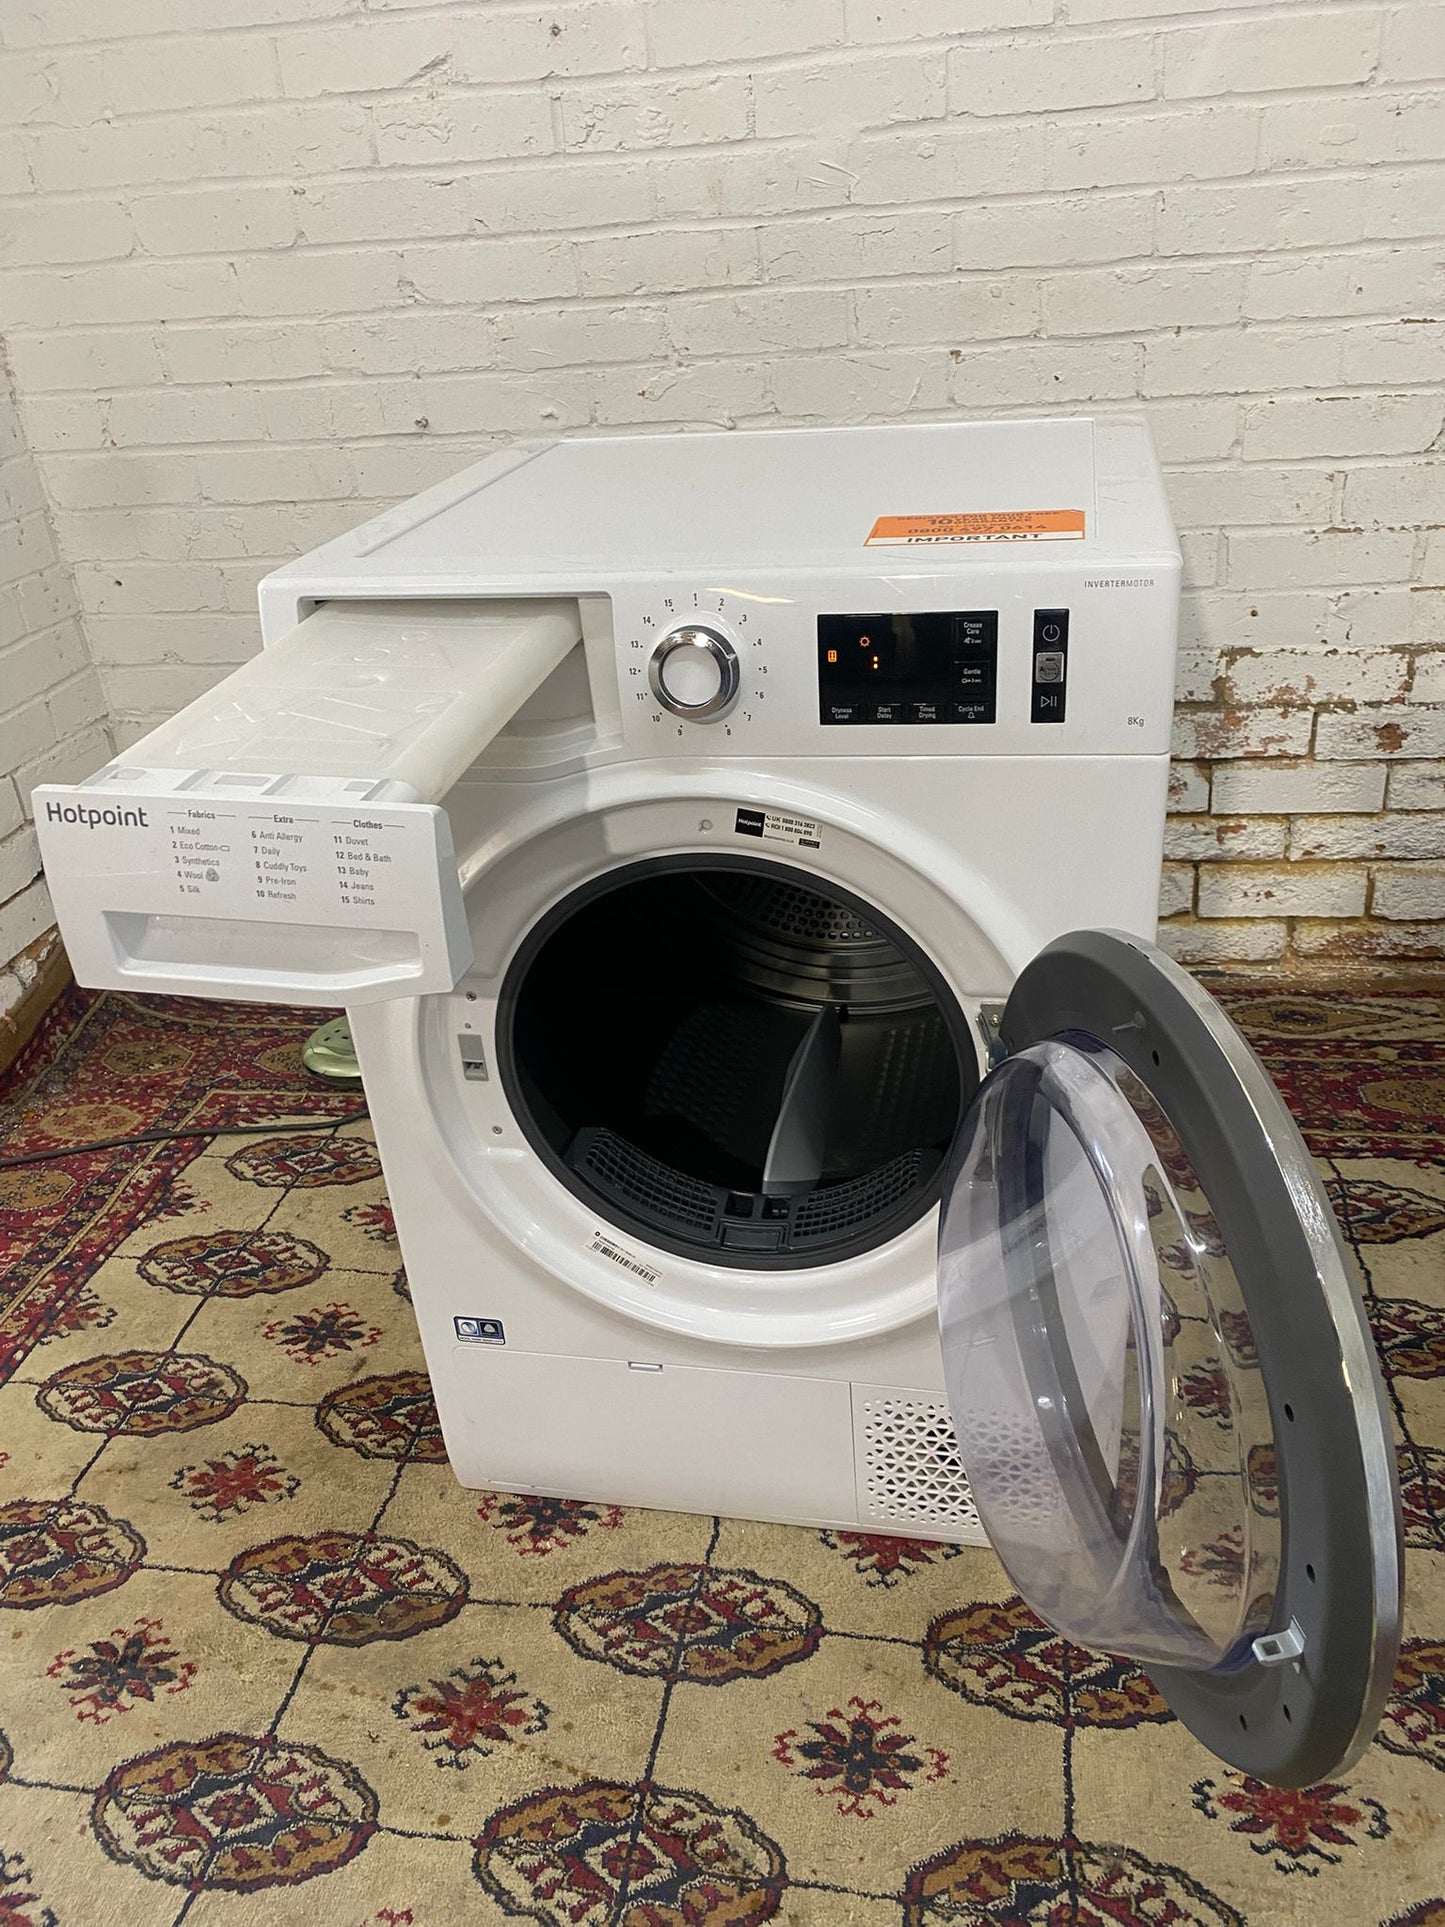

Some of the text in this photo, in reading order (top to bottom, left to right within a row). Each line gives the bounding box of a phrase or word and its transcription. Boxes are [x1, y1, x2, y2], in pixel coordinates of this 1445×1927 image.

[907, 533, 1043, 543] IMPORTANT
[1084, 580, 1155, 588] INVERTERMOTOR
[693, 593, 697, 601] 1
[719, 598, 725, 606] 2
[664, 599, 673, 607] 15
[643, 616, 651, 624] 14
[742, 614, 747, 622] 3
[963, 621, 983, 629] Crease
[756, 638, 762, 646] 4
[629, 667, 637, 675] 12
[763, 666, 768, 674] 5
[636, 693, 644, 701] 11
[759, 691, 765, 699] 6
[958, 705, 973, 713] Cycle
[877, 712, 892, 720] Delay
[918, 712, 936, 720] Drying
[1127, 716, 1144, 728] 8Kg
[678, 728, 683, 736] 9
[726, 728, 732, 736] 8
[46, 801, 149, 830] Hotpoint
[188, 809, 216, 820] Fabrics
[273, 814, 294, 824] Extra
[353, 819, 383, 830] Clothes
[170, 825, 200, 836] 1 Mixed
[251, 830, 303, 843] 6 Anti Allergy
[333, 835, 369, 846] 11 Duvet
[172, 841, 219, 851] 2 Eco Cotton
[253, 845, 281, 857] 7 Daily
[174, 856, 220, 867] 3 Synthetics
[336, 851, 392, 863] 12 Bed & Bath
[255, 861, 307, 873] 8 Cuddly Toys
[337, 866, 369, 878] 13 Baby
[177, 870, 204, 880] 4 Wool
[257, 875, 297, 886] 9 Pre-Iron
[180, 885, 201, 894] 5 Silk
[339, 881, 375, 891] 14 Jeans
[256, 890, 297, 900] 10 Refresh
[341, 896, 375, 906] 15 Shirts
